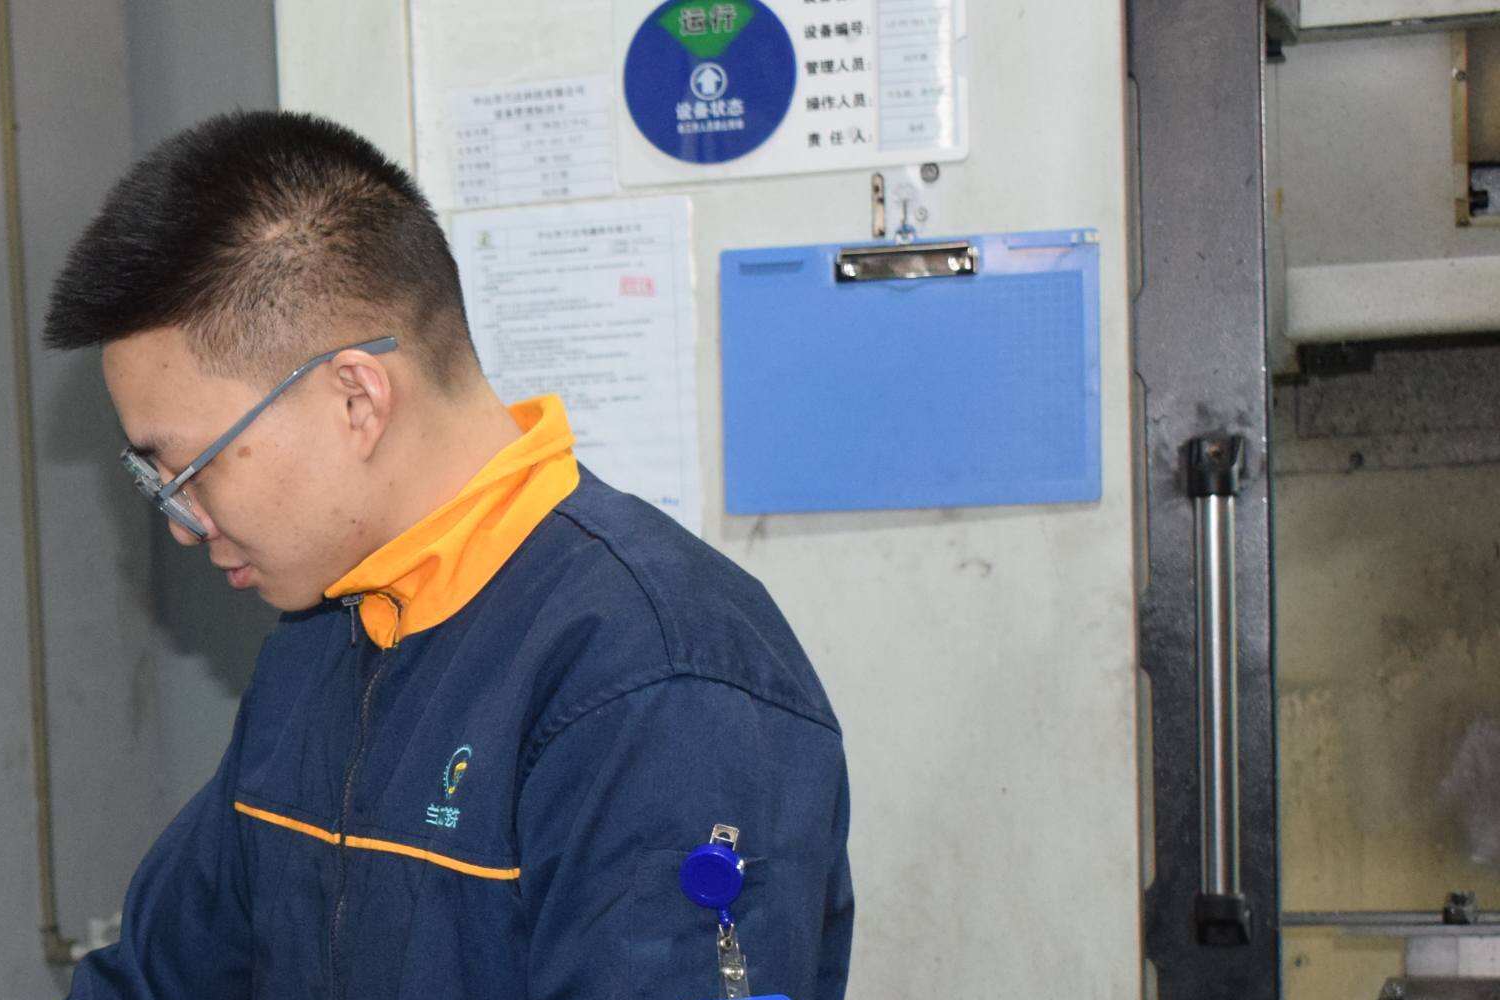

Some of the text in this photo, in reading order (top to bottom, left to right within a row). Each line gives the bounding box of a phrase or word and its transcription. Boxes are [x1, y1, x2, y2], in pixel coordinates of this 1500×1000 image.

[679, 4, 736, 36] 运行
[675, 98, 745, 120] 设备状态
